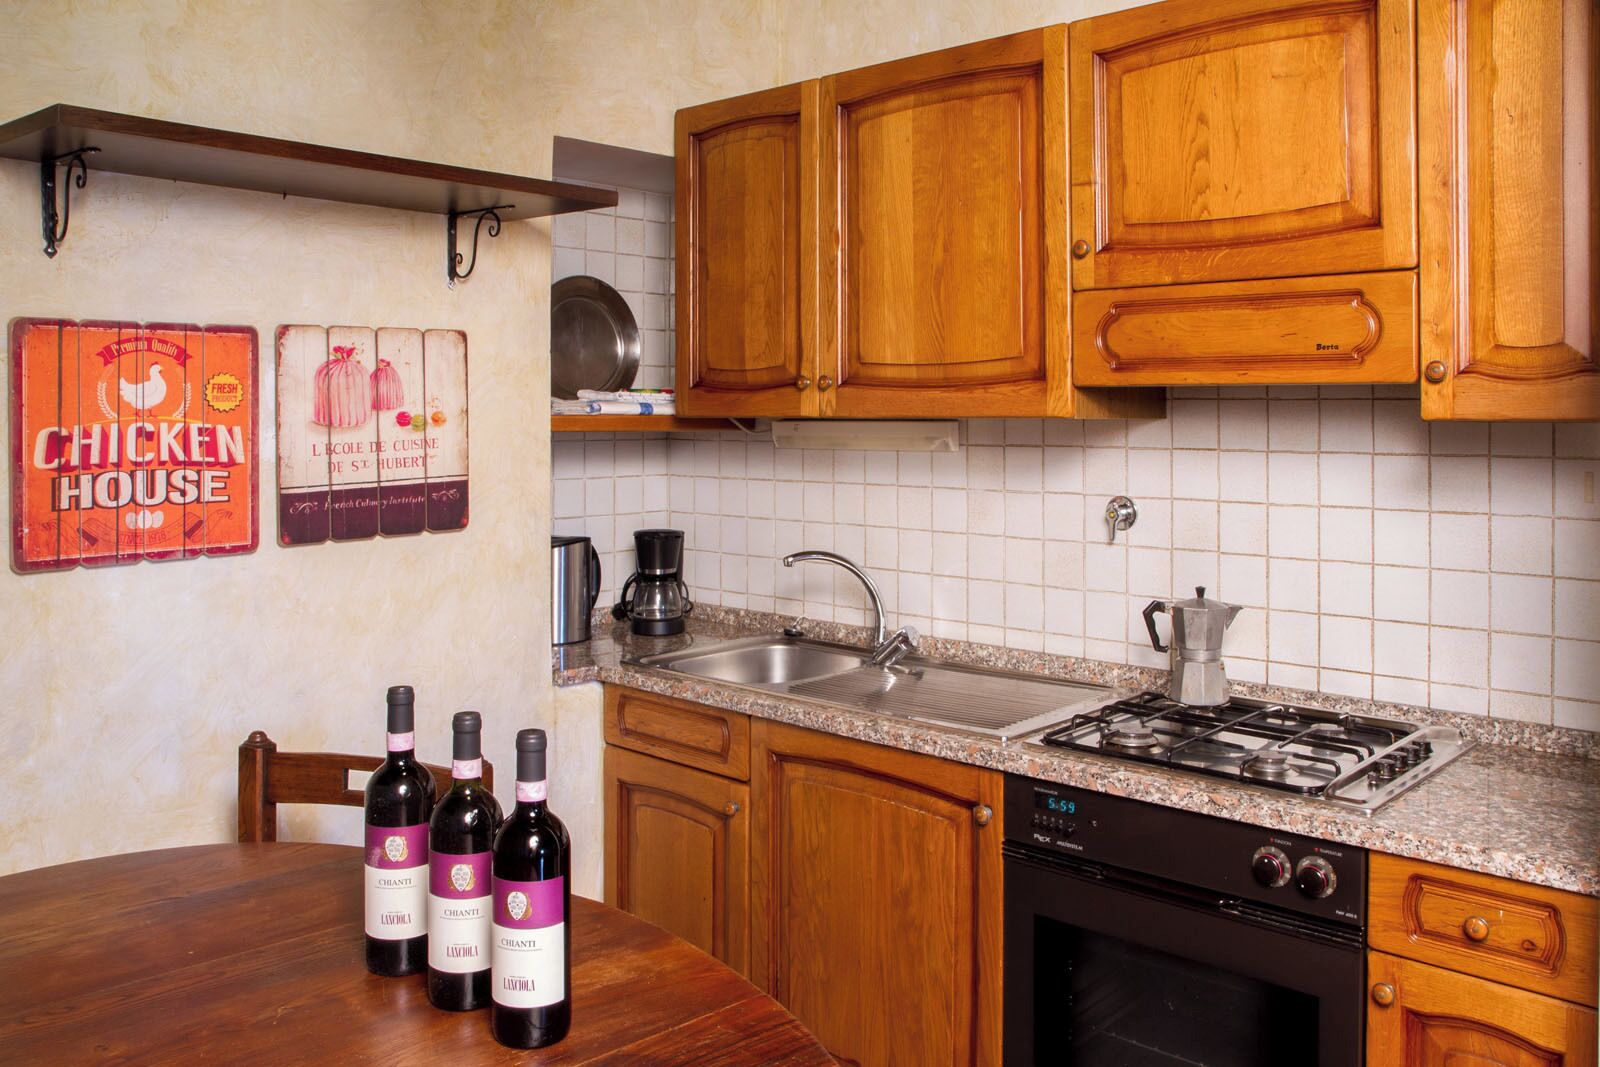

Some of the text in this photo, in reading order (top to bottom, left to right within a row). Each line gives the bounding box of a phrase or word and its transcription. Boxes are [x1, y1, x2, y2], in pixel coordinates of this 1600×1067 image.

[151, 338, 178, 357] Quality
[211, 383, 238, 394] FRESH
[33, 422, 245, 470] CHICKEN
[369, 440, 387, 453] DE
[393, 437, 439, 452] CUISINE
[327, 460, 344, 474] DE
[377, 455, 427, 471] HUBERT
[51, 468, 230, 512] HOUSE
[1033, 833, 1052, 843] REX
[378, 878, 412, 887] CHIANTI
[444, 908, 480, 917] CHIANTI
[501, 938, 537, 948] CHIANTI
